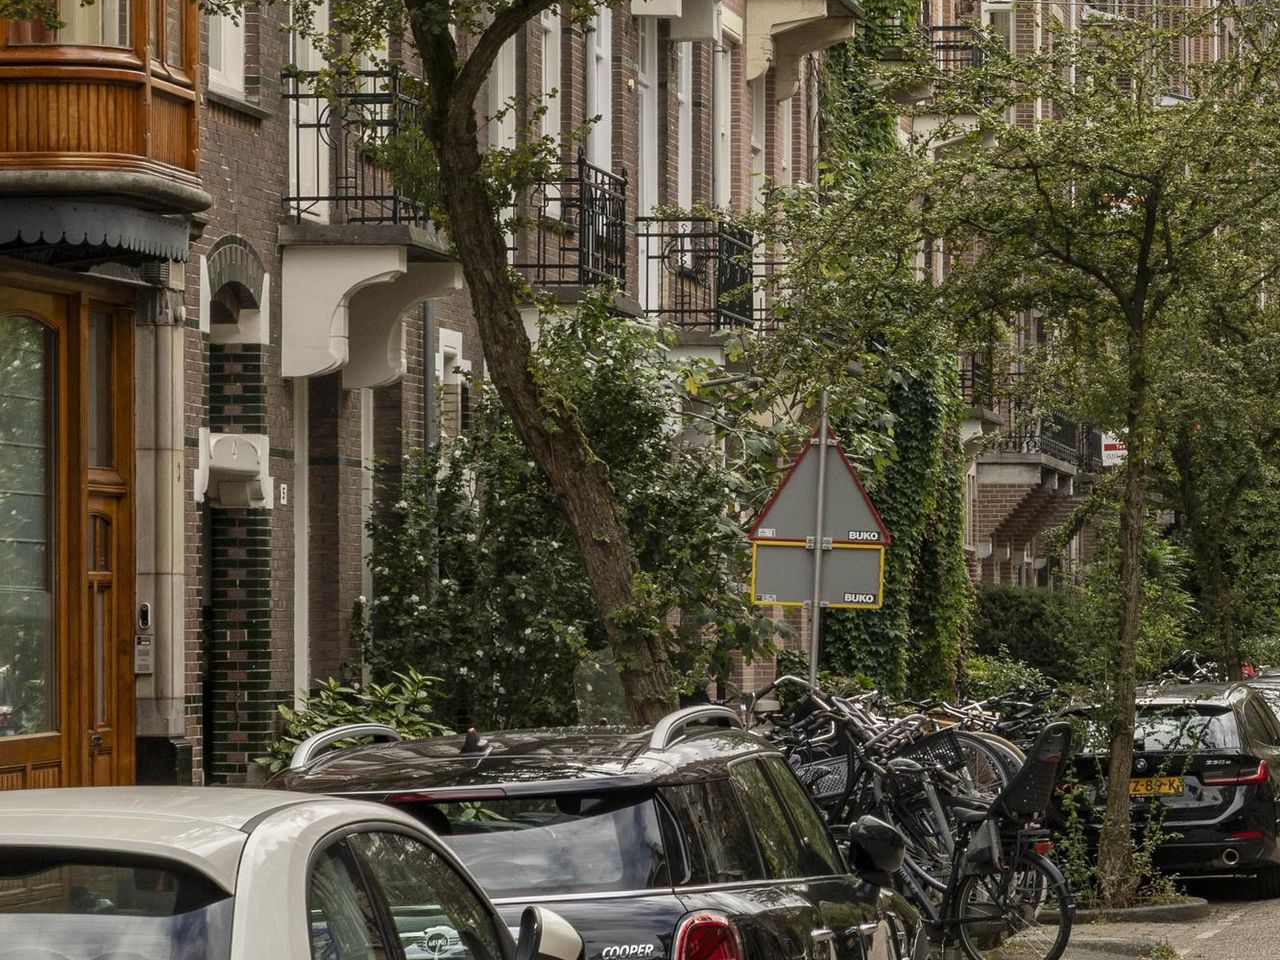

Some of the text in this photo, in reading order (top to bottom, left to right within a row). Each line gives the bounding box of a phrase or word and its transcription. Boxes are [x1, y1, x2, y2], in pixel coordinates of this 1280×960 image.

[848, 531, 878, 541] BUKO
[844, 593, 874, 603] BUKO
[602, 944, 654, 960] COOPER
